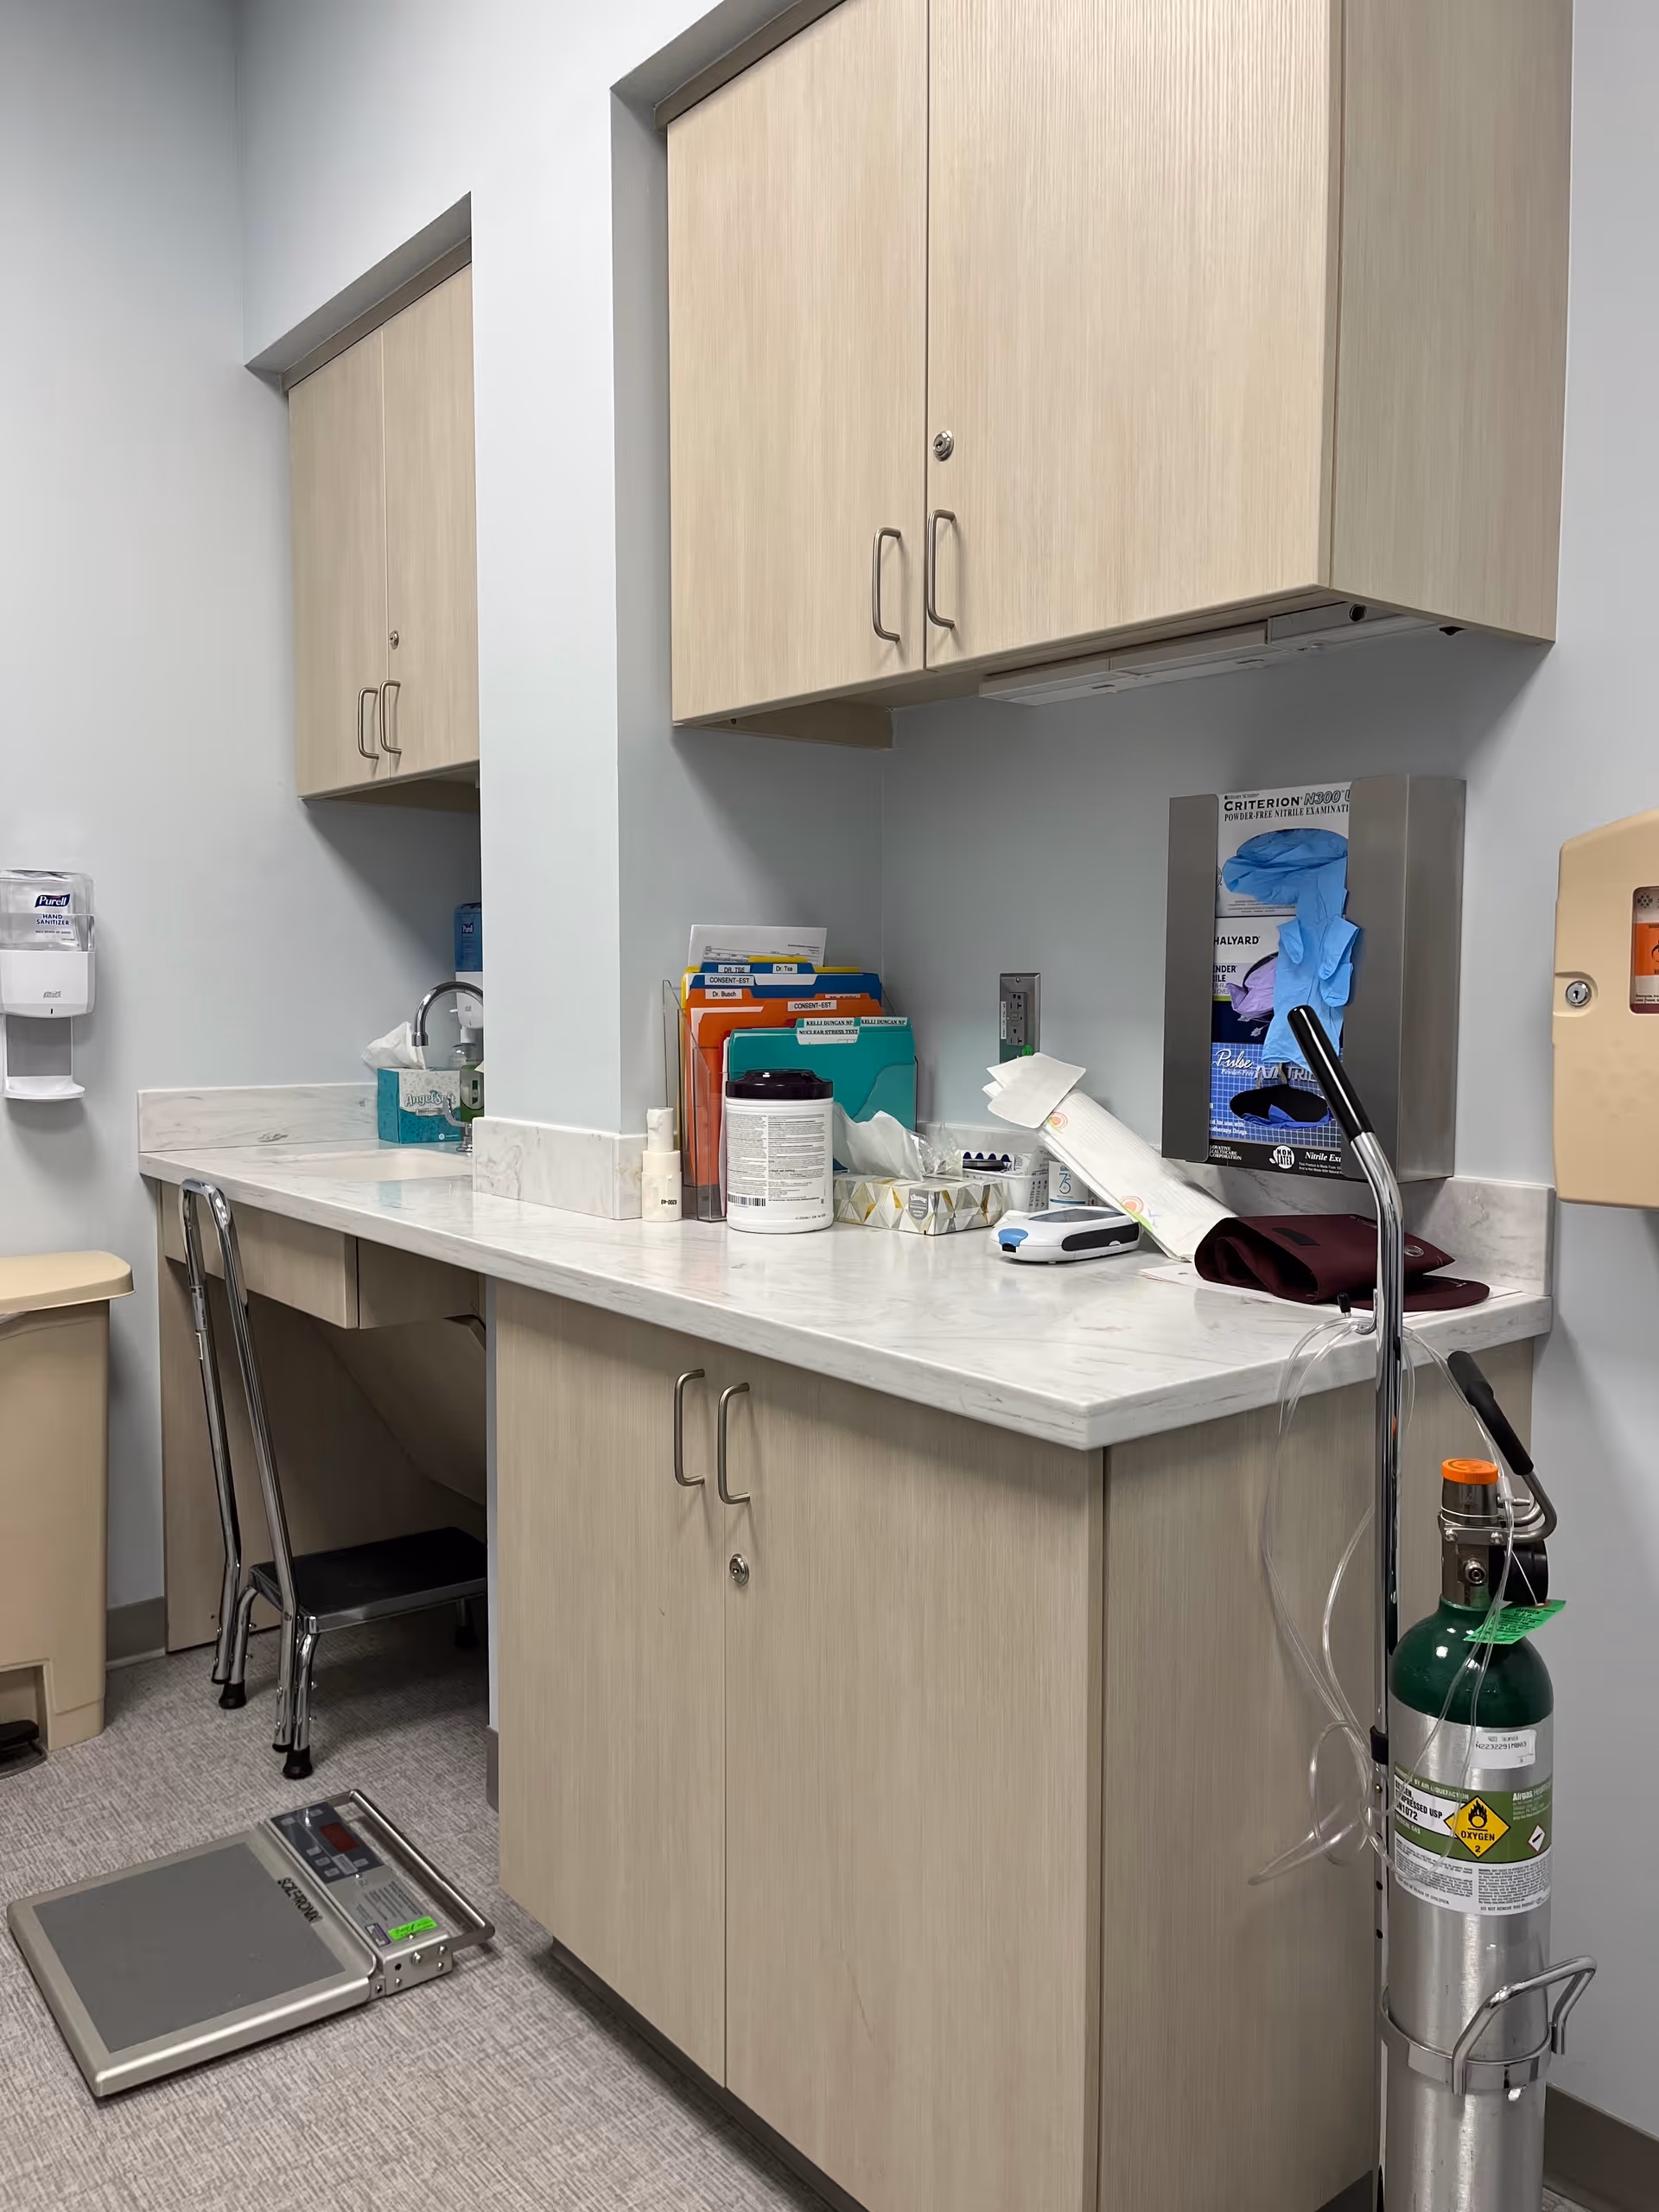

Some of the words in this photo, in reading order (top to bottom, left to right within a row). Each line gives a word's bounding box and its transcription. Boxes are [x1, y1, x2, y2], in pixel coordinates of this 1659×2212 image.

[1224, 796, 1300, 811] CRITERION
[1224, 810, 1273, 822] POWDER-FREE
[1274, 807, 1304, 818] NITRILE
[1214, 936, 1259, 945] HALYARD
[1216, 1048, 1253, 1069] Pulse
[1254, 1065, 1318, 1083] NITRIL
[404, 1093, 435, 1107] Angel
[1305, 1151, 1328, 1161] Nitrile
[1395, 1789, 1428, 1815] MPRESSED
[1429, 1808, 1443, 1819] USP
[1460, 1830, 1495, 1841] OXYGEN
[1474, 1845, 1481, 1853] 2
